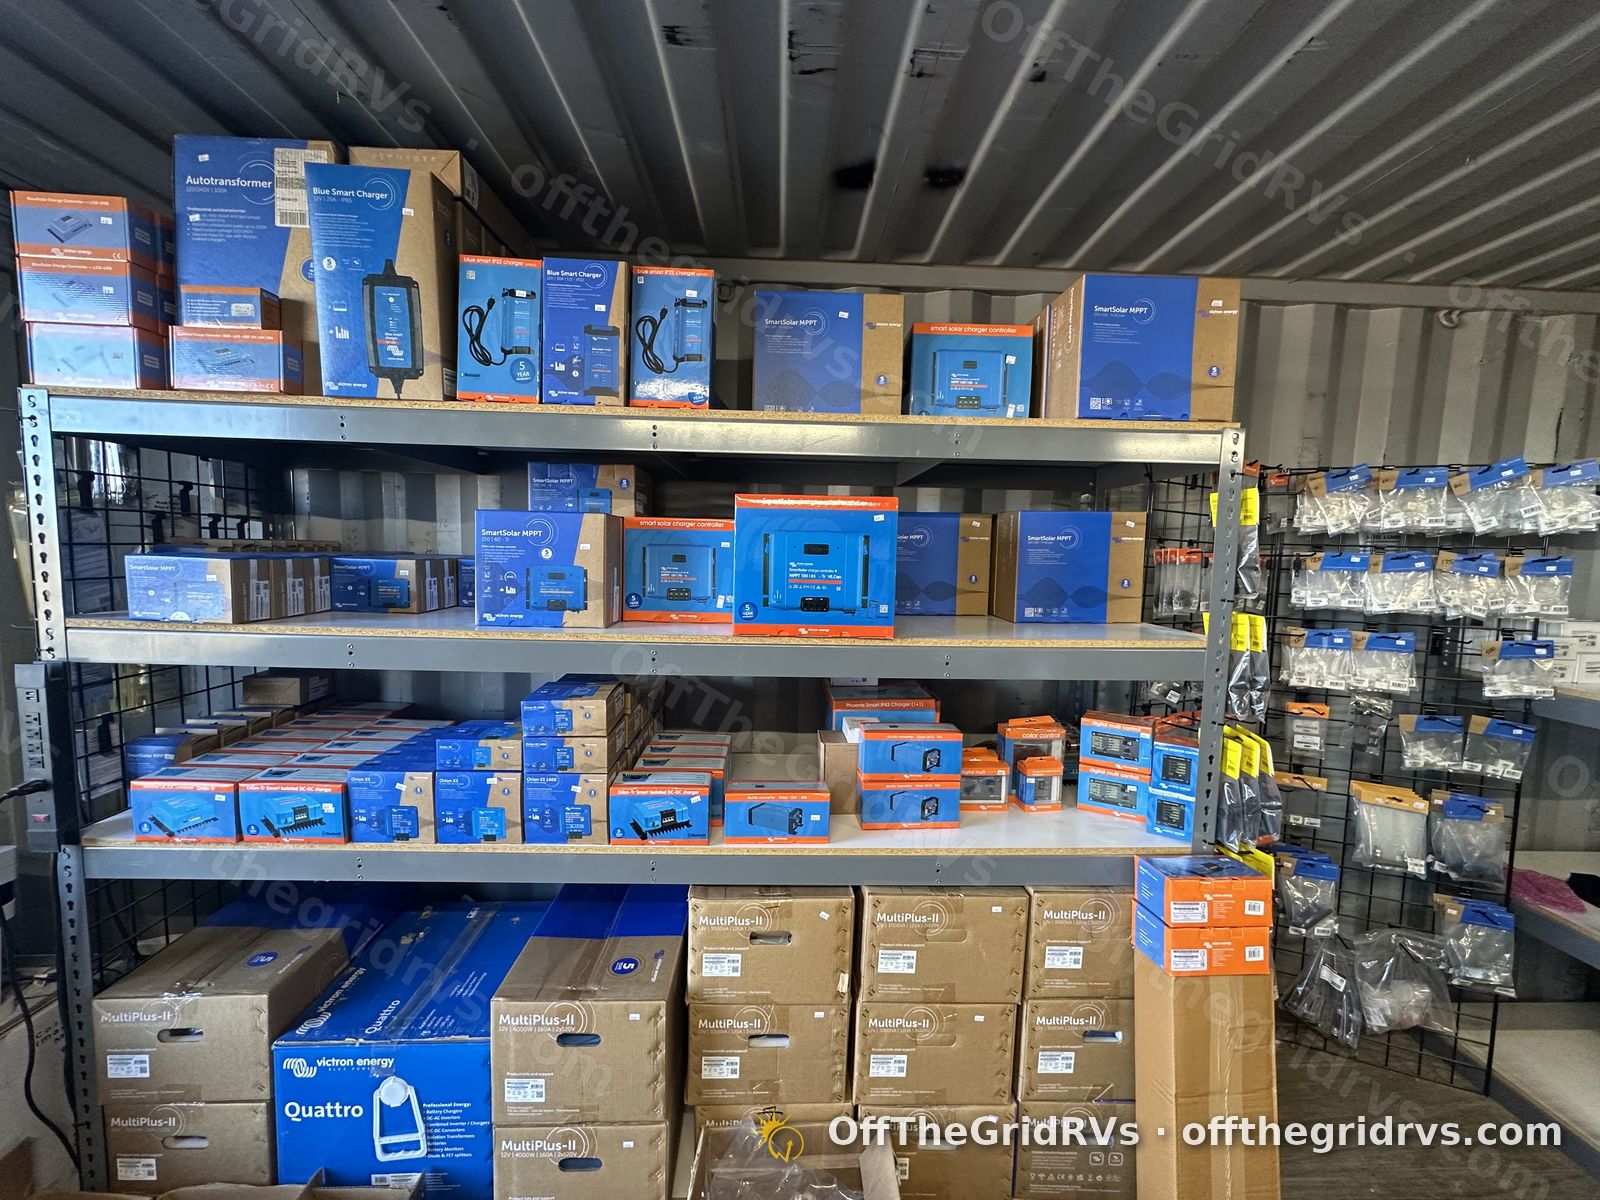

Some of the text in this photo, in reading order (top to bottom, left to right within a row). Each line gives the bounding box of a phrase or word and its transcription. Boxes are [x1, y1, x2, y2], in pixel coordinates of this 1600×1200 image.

[186, 176, 272, 188] Autotransformer
[313, 187, 388, 200] Blue Smart Charger
[503, 259, 523, 267] charger
[579, 271, 601, 279] Charger
[519, 362, 525, 370] 5
[482, 529, 521, 537] SmartSolar
[877, 913, 938, 922] MultiPlus-II
[1044, 911, 1105, 919] MultiPlus-II
[699, 916, 762, 925] MultiPlus-II
[101, 1011, 174, 1023] MultiPlus-II
[365, 1000, 400, 1035] Quattro
[499, 1014, 574, 1025] MultiPlus-II
[1036, 1016, 1096, 1025] MultiPlus-II
[698, 1019, 761, 1029] MultiPlus-II
[868, 1019, 929, 1028] MultiPlus-II
[316, 1057, 395, 1068] victron energy
[284, 1102, 363, 1122] Quattro
[110, 1117, 177, 1127] MultiPlus-II
[501, 1140, 576, 1151] MultiPlus-II
